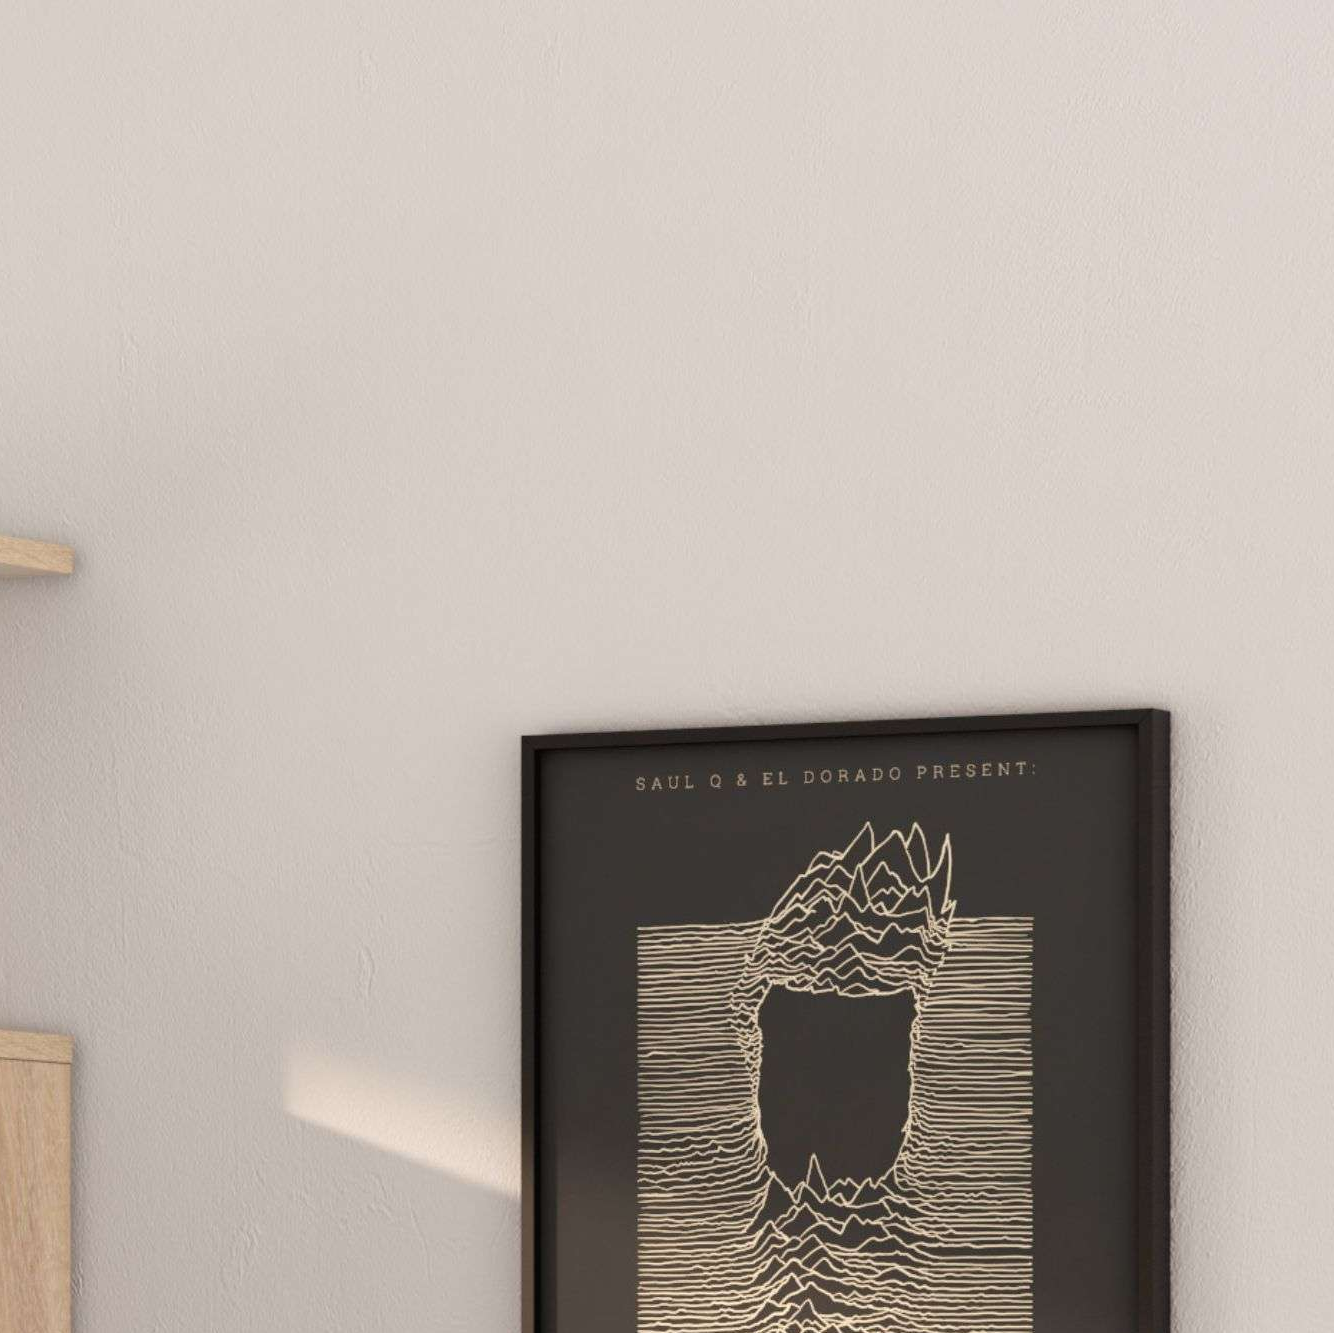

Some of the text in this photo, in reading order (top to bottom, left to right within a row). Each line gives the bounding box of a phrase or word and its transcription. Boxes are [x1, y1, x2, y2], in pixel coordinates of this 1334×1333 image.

[634, 761, 1037, 792] SAUL Q & EL DORADO PRESENT:
